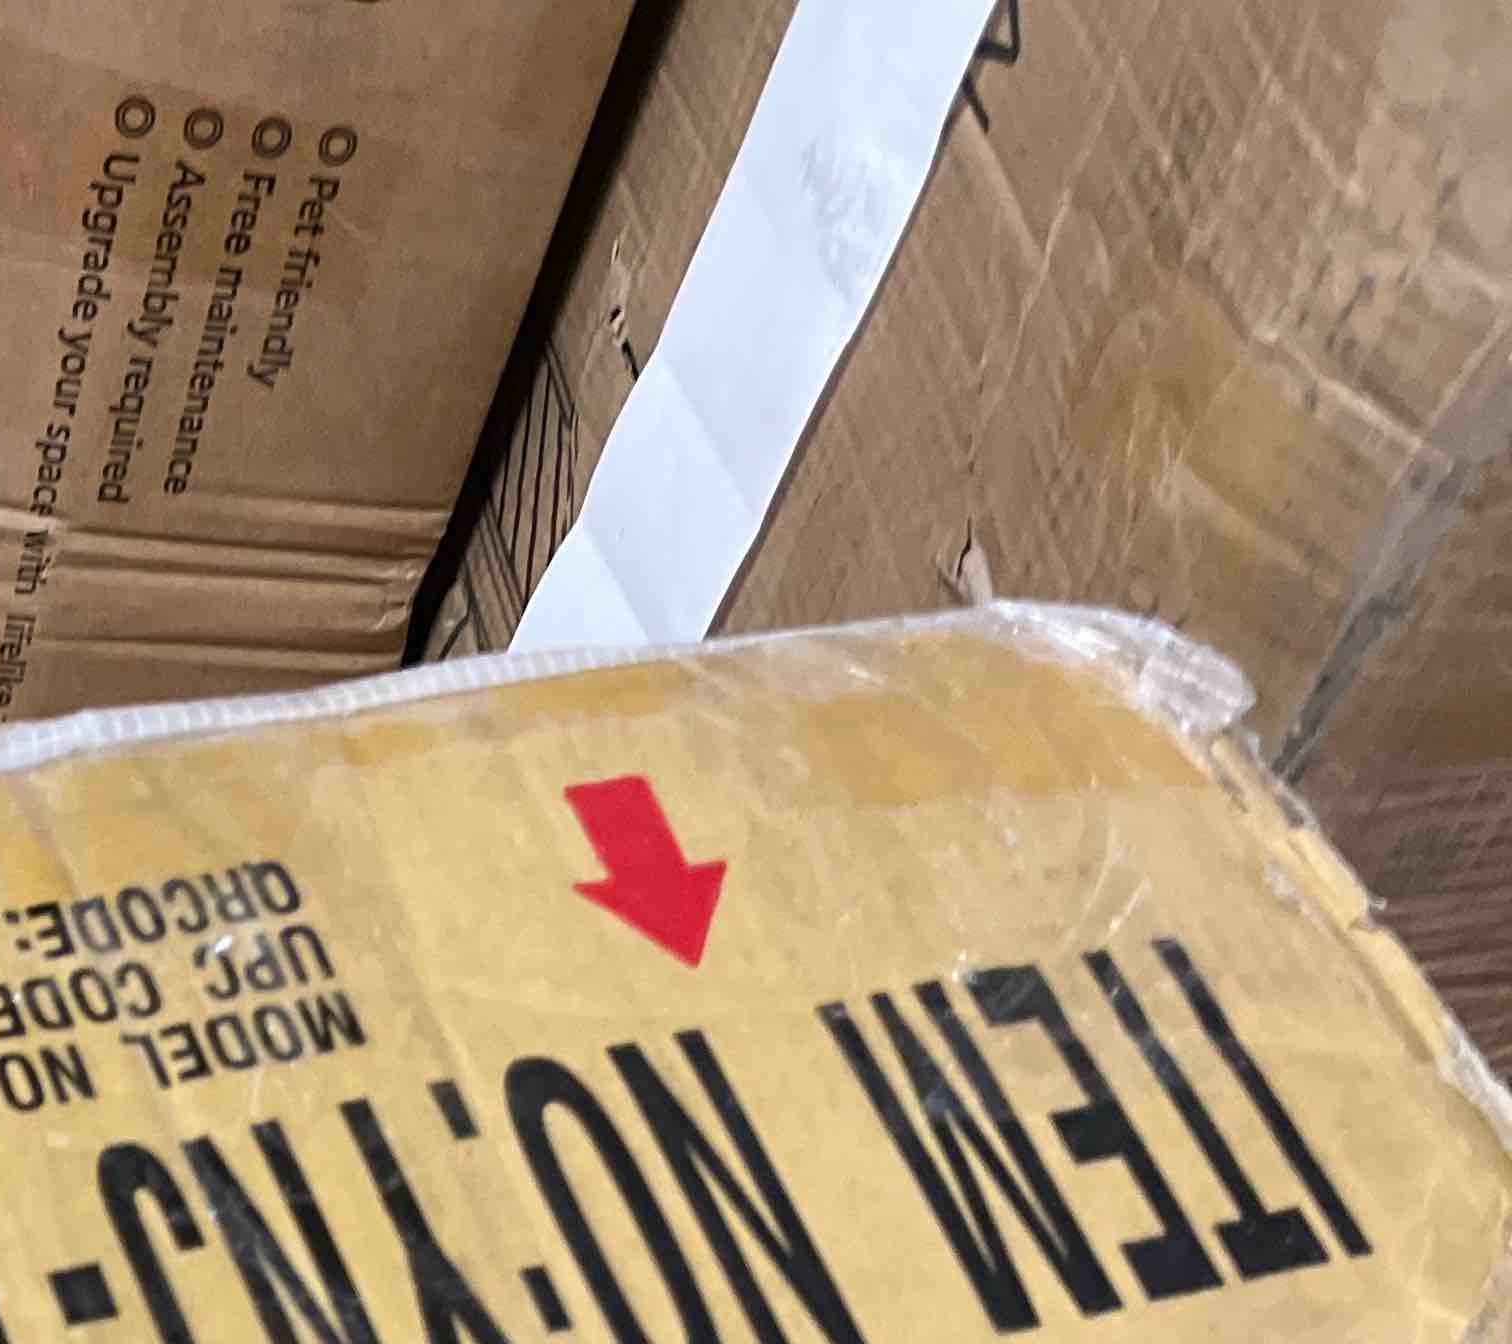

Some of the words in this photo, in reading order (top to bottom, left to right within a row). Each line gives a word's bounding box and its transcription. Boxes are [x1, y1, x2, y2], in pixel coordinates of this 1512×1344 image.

[73, 151, 140, 322] Upgrade
[127, 159, 207, 348] Assembly
[224, 169, 276, 257] Free
[294, 175, 341, 237] Pet
[247, 247, 321, 393] friendly
[54, 327, 93, 416] your
[164, 265, 243, 496] maintenance
[29, 422, 71, 516] space
[97, 353, 154, 504] required
[15, 529, 51, 595] with
[4, 861, 301, 960] QRCODE:
[120, 991, 366, 1090] MODEL
[818, 937, 1374, 1337] ITEM
